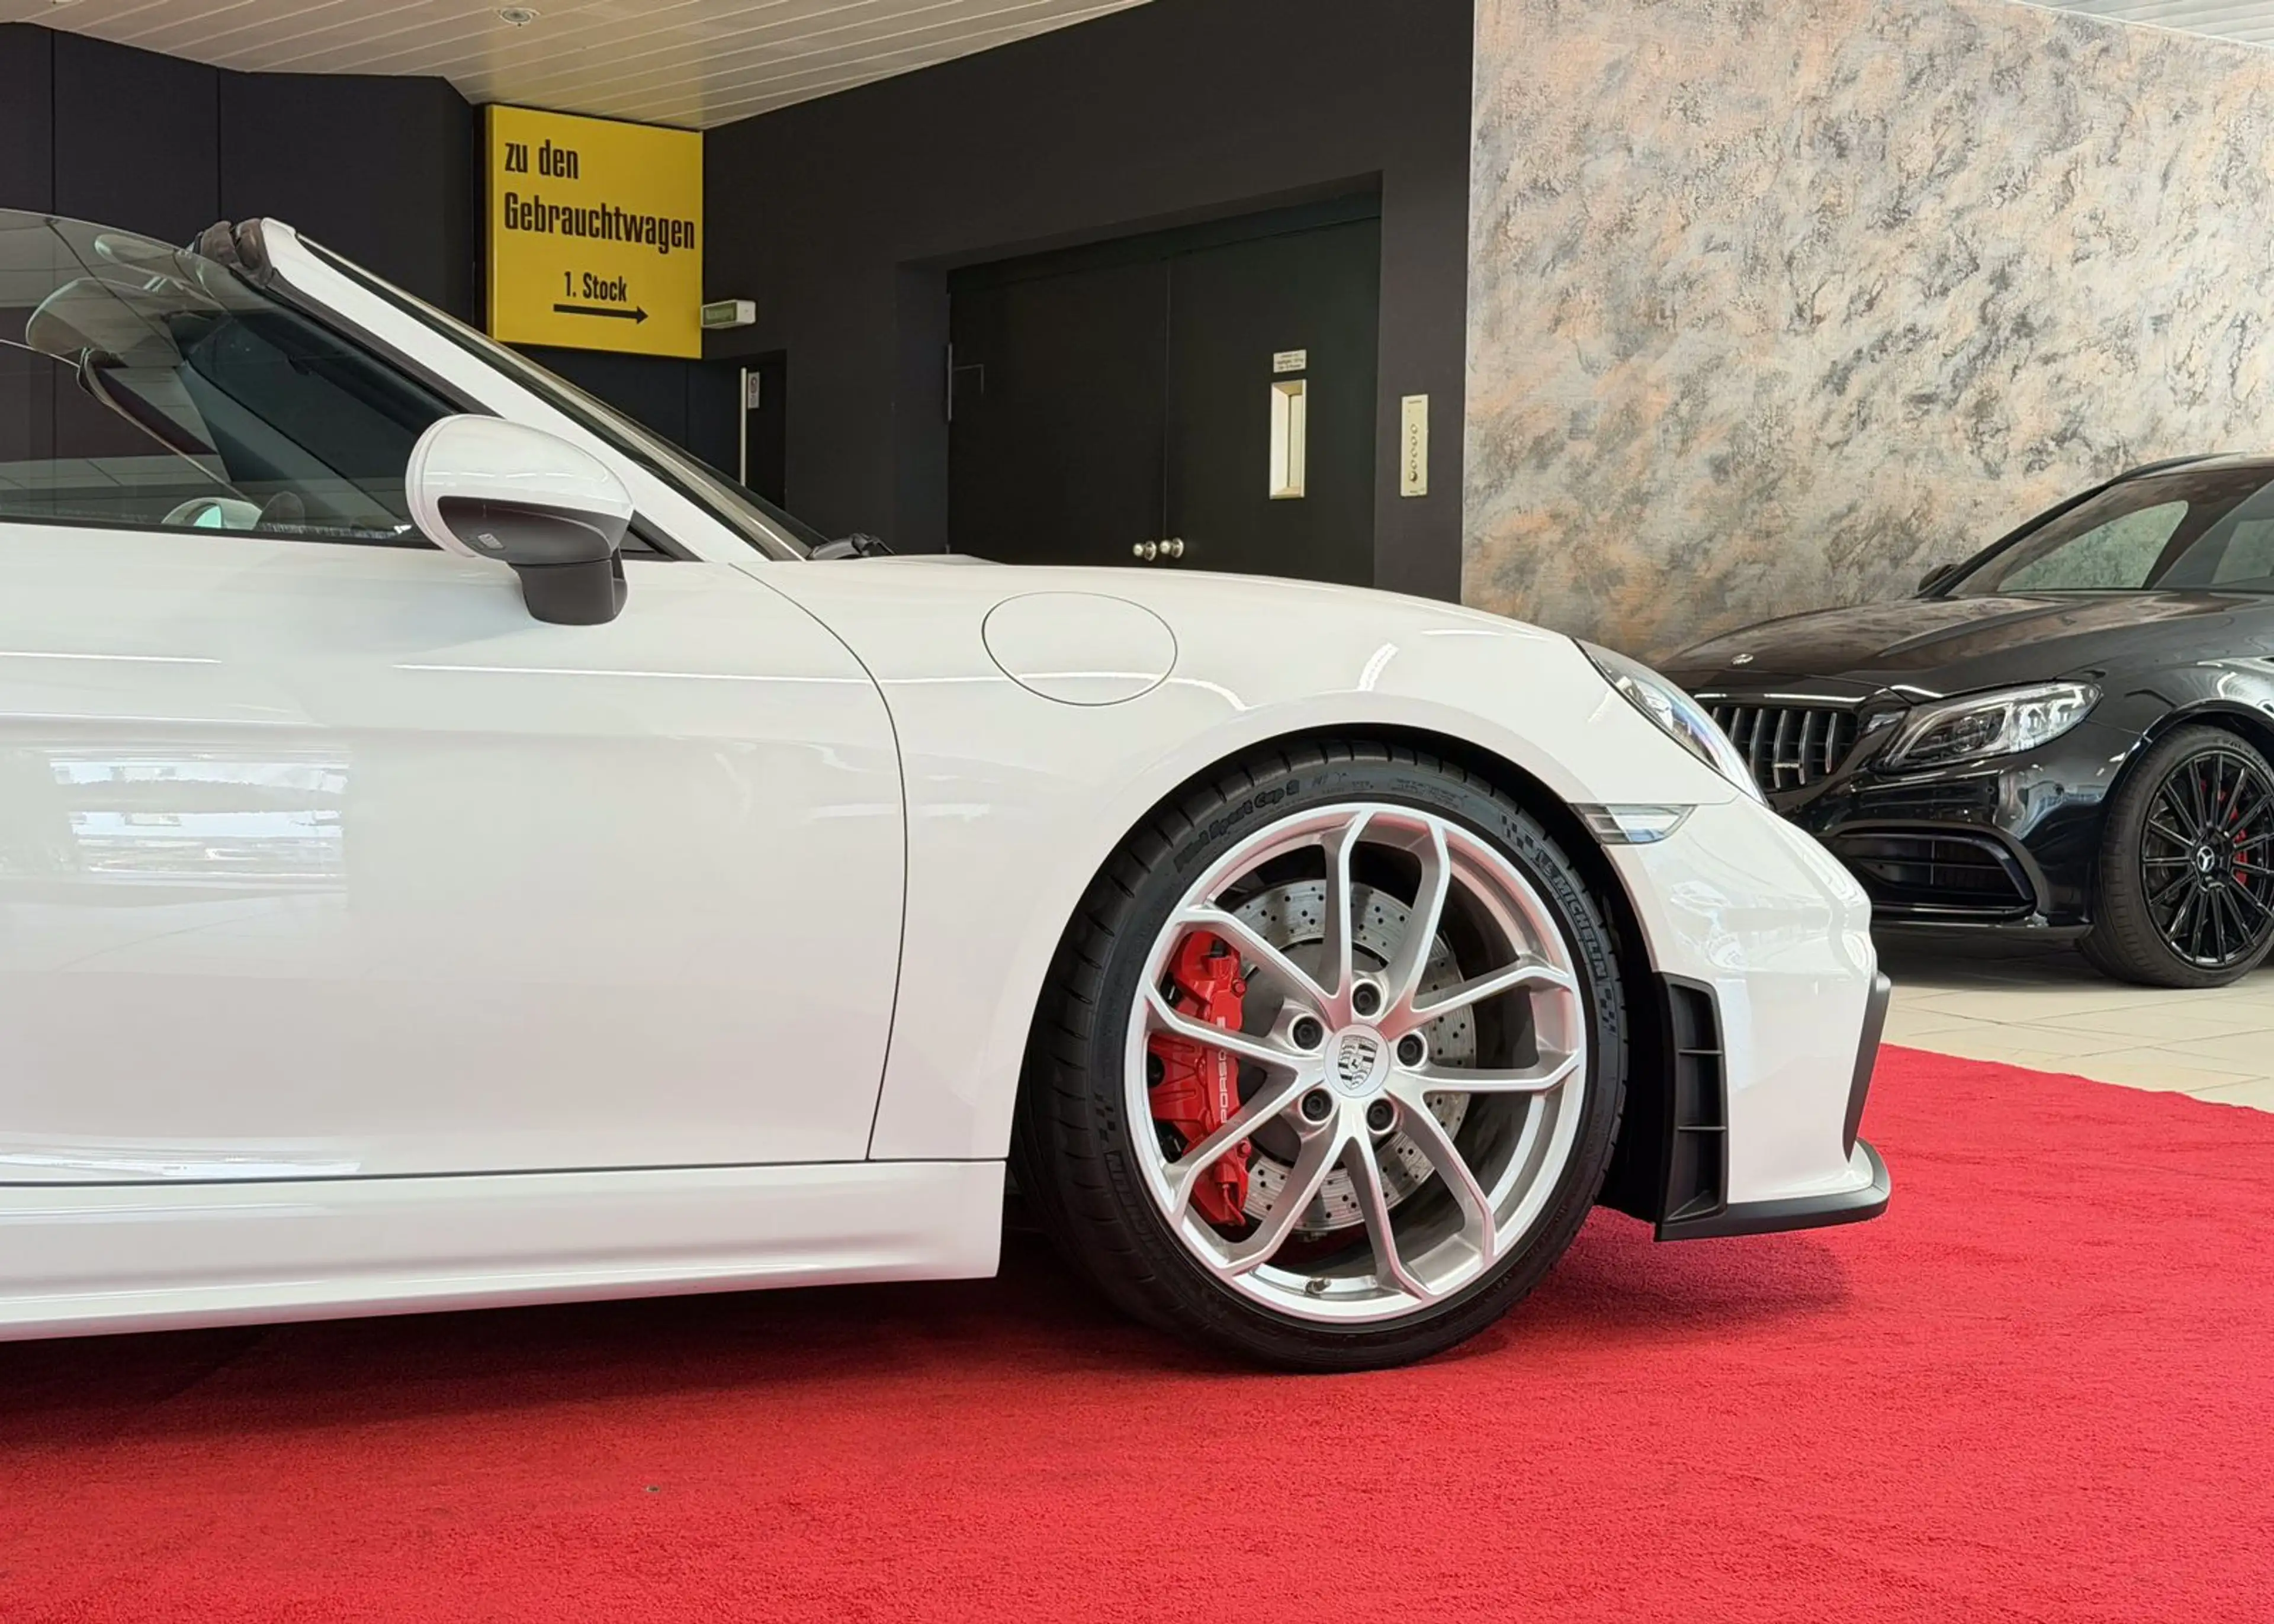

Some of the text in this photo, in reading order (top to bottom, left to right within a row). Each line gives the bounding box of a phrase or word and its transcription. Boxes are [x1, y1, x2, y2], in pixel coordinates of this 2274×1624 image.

[505, 140, 578, 179] zu den
[505, 192, 694, 254] Gebrauchtwagen
[565, 272, 626, 301] 1. Stock
[1552, 876, 1607, 977] MICHELIN
[1217, 1016, 1228, 1123] PORSCE
